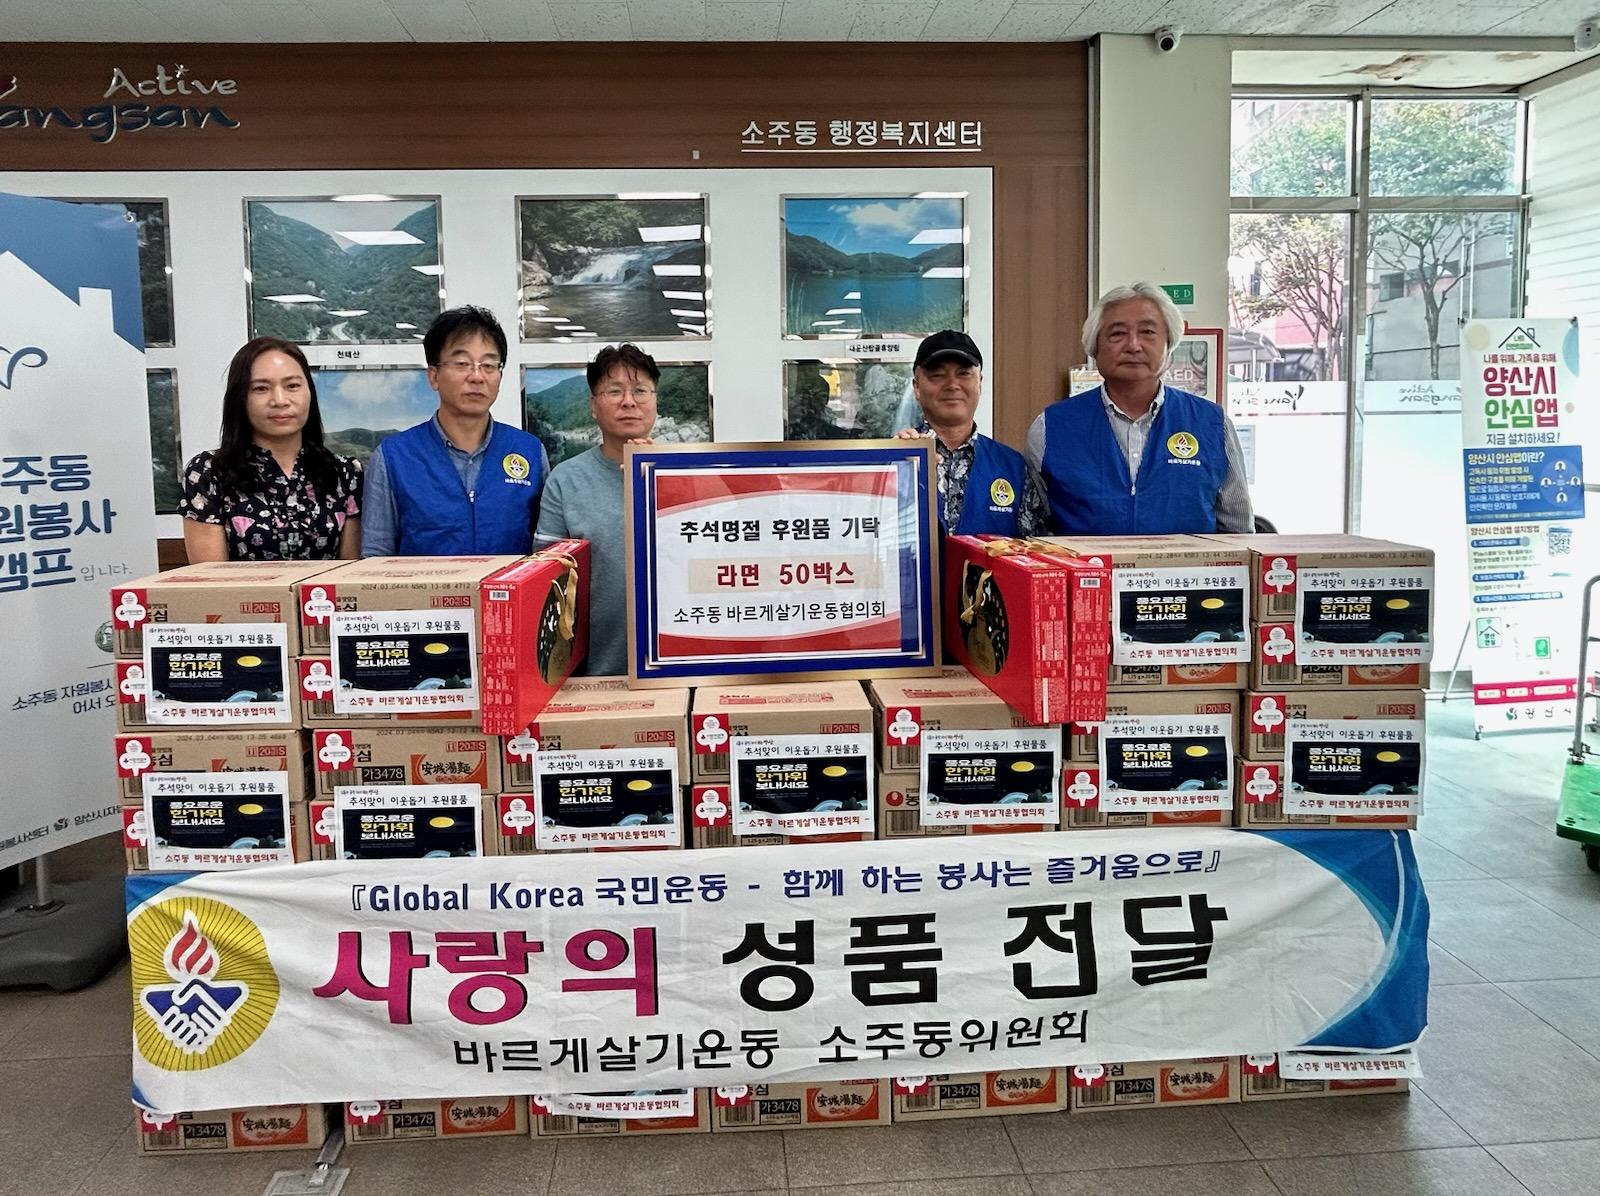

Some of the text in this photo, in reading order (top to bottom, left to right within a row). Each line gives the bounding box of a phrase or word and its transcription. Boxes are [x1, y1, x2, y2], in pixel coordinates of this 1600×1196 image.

[104, 64, 238, 98] Active
[742, 120, 982, 146] 소주동 행정복지센터
[1484, 354, 1498, 363] 나를
[1518, 354, 1540, 363] 가족을
[1541, 353, 1557, 362] 위해
[1163, 370, 1193, 381] AED
[1483, 367, 1556, 396] 양산시
[1484, 398, 1558, 429] 안심앱
[1486, 432, 1560, 445] 지금 설치하세요!
[1468, 452, 1545, 465] 양산시 안심앱이란?
[680, 516, 880, 543] 추석명절 후원품 기탁
[717, 562, 856, 588] 라면 50박스
[1127, 577, 1237, 588] 추석맞이 이웃돕기 후원물품
[1311, 578, 1423, 588] 추석맞이 이웃돕기 후원물품
[1136, 596, 1187, 604] 풍요로운
[674, 600, 886, 624] 소주동 바르게살기운동협의회
[1136, 604, 1186, 613] 한가위
[1320, 604, 1371, 613] 한가위
[1136, 613, 1187, 621] 보내세요
[344, 621, 462, 633] 추석맞이 이웃돕기 후원물품
[157, 634, 274, 645] 추석맞이 이웃돕기 후원물품
[355, 641, 409, 649] 풍요로운
[168, 653, 222, 661] 풍요로운
[356, 649, 408, 659] 한가위
[1130, 648, 1237, 658] 소주동 바르게살기운동협의회
[1311, 648, 1421, 658] 소주동 바르게살기운동협의회
[169, 661, 221, 671] 한가위
[356, 659, 410, 667] 보내세요
[12, 689, 57, 710] 소주동
[350, 695, 464, 706] 소주동 바르게살기운동협의회
[73, 698, 101, 714] 어서
[162, 707, 276, 717] 소주동 바르게살기운동협의회
[1112, 724, 1220, 734] 추석맞이 이웃돕기 후원물품
[1300, 730, 1413, 740] 추석맞이 이웃돕기 후원물품
[745, 744, 859, 756] 추석맞이 이웃돕기 후원물품
[936, 740, 1047, 751] 추석맞이 이웃돕기 후원물품
[1122, 743, 1171, 751] 풍요로운
[1122, 751, 1171, 760] 한가위
[1309, 755, 1361, 765] 한가위
[547, 757, 664, 771] 추석맞이 이웃돕기 후원물품
[945, 758, 997, 767] 풍요로운
[755, 764, 808, 772] 풍요로운
[945, 766, 996, 776] 한가위
[364, 768, 403, 779] 가3478
[756, 771, 807, 782] 한가위
[559, 778, 612, 786] 풍요로운
[945, 775, 996, 783] 보내세요
[158, 783, 276, 793] 추석맞이 이웃돕기 후원물품
[560, 786, 611, 796] 한가위
[756, 782, 809, 790] 보내세요
[350, 794, 468, 806] 추석맞이 이웃돕기 후원물품
[559, 796, 613, 804] 보내세요
[1114, 796, 1219, 805] 소주동 바르게살기운동협의회
[1300, 800, 1409, 808] 소주동 바르게살기운동협의회
[170, 809, 222, 818] 한가위
[360, 814, 414, 822] 풍요로운
[936, 808, 1044, 819] 소주동 바르게살기운동협의회
[749, 816, 859, 827] 소주동 바르게살기운동협의회
[361, 822, 412, 832] 한가위
[360, 832, 415, 840] 보내세요
[552, 830, 666, 842] 소주동 바르게살기운동협의회
[165, 853, 278, 863] 소주동 바르게살기운동협의회
[352, 882, 470, 912] 『Global
[490, 881, 583, 910] Korea
[595, 873, 729, 906] 국민운동
[784, 866, 844, 898] 함께
[862, 863, 923, 895] 하는
[937, 858, 1031, 891] 봉사는
[1046, 850, 1222, 883] 즐거움으로』
[313, 892, 1229, 1025] 사랑의 성품 전달
[454, 1010, 1089, 1074] 바르게살기운동 소주동위원회
[1295, 1060, 1406, 1072] 소주동 바르게살기운동협의회
[568, 1099, 679, 1111] 소주동 바르게살기운동협의회
[761, 1100, 799, 1114] 가3478
